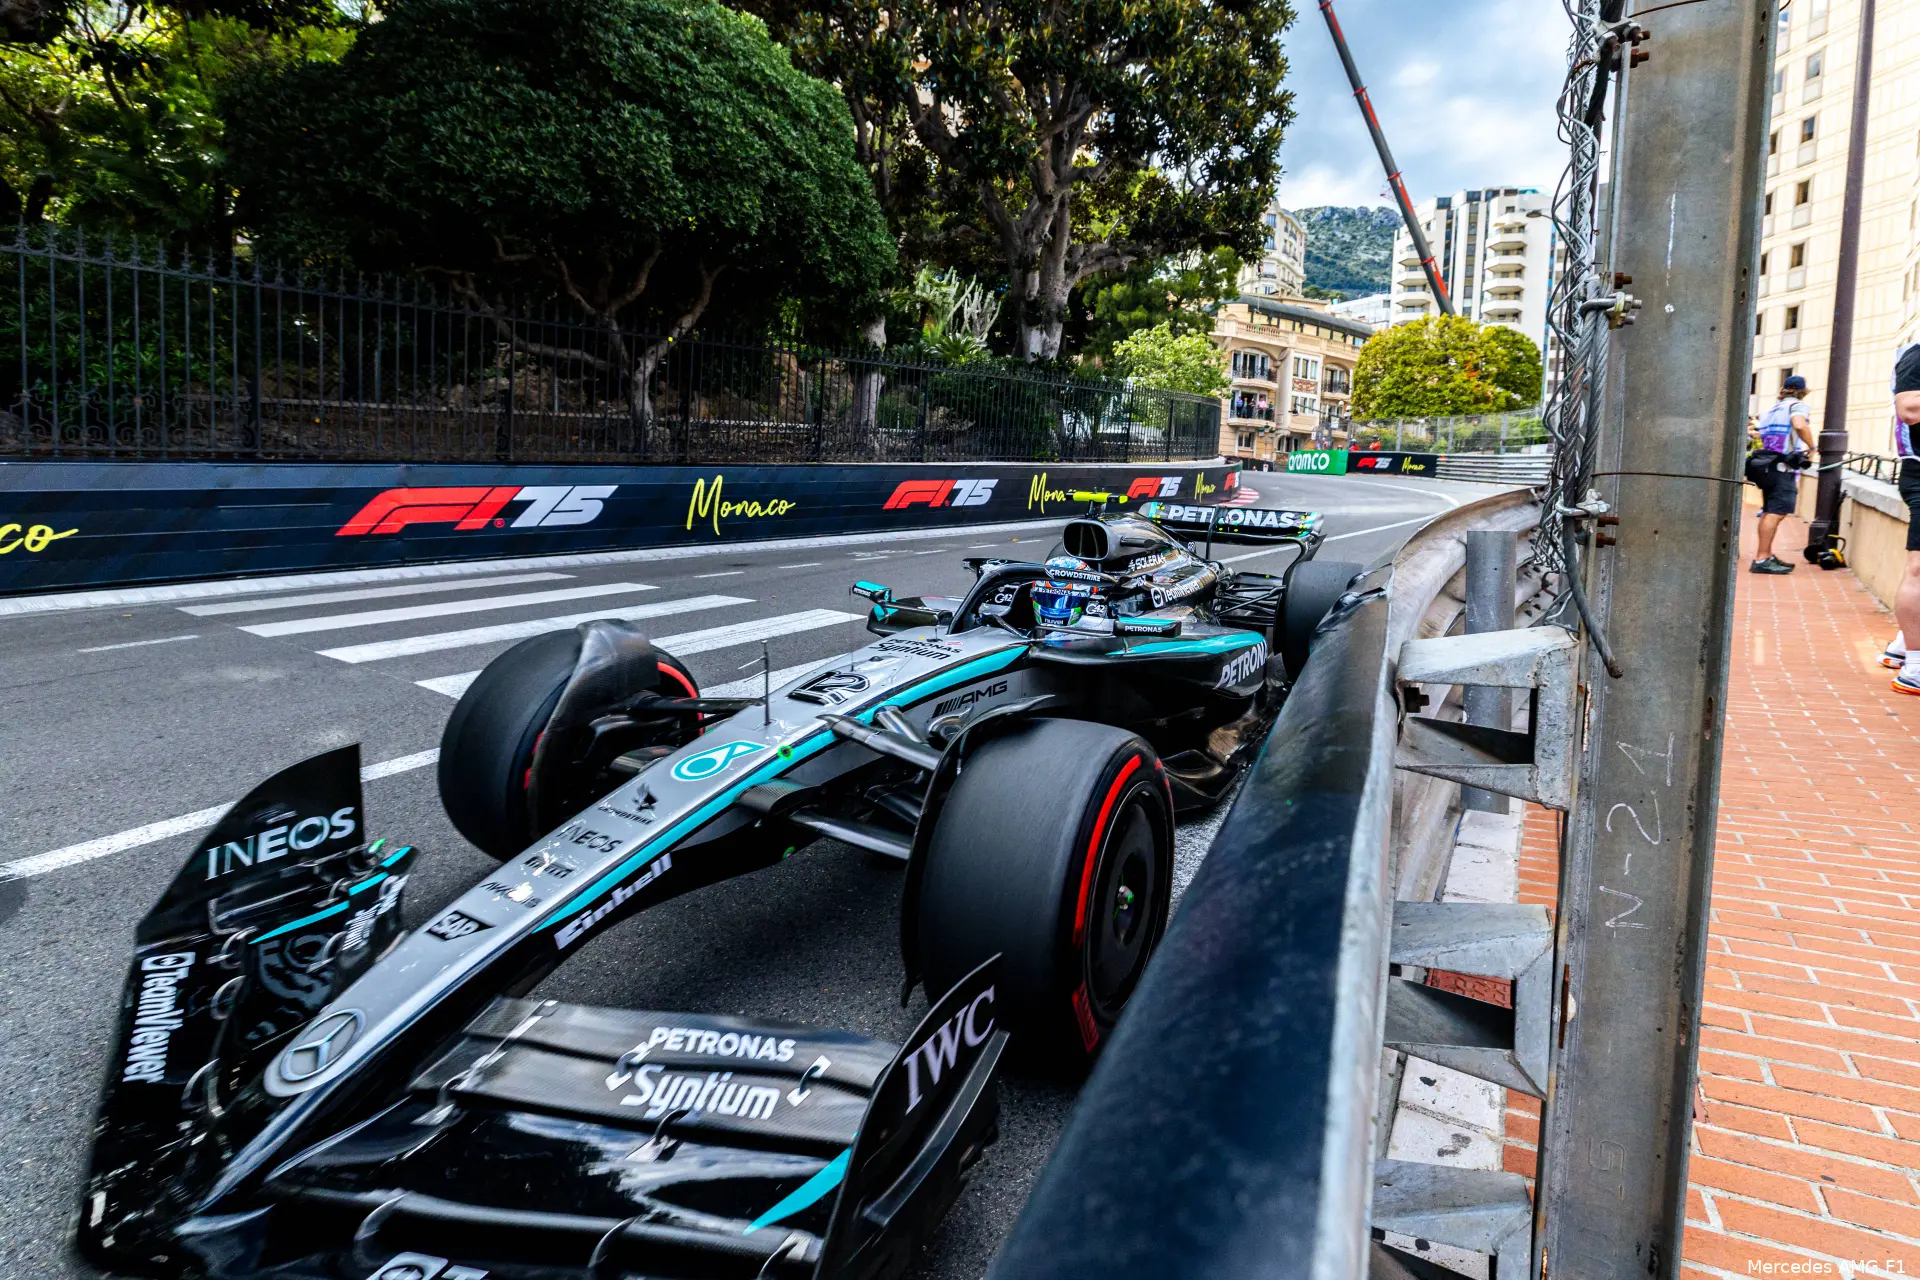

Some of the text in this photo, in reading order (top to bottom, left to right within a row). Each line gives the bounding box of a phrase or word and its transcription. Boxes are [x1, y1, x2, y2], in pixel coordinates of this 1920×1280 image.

[1288, 452, 1331, 471] aramco
[334, 485, 619, 536] F1 75
[686, 475, 796, 535] Monaco
[882, 478, 999, 510] F1 75
[1028, 472, 1077, 514] Mona
[1049, 569, 1101, 582] CROWDSTRIKE
[1124, 625, 1163, 633] PETRONAS
[205, 806, 356, 881] INEOS
[556, 823, 623, 853] INEOS
[554, 852, 673, 950] Einhell
[431, 913, 482, 938] SAP
[122, 968, 190, 1084] TeamViewer
[646, 1026, 797, 1064] PETRONAS
[903, 984, 996, 1116] IWC
[619, 1063, 782, 1121] Syntium
